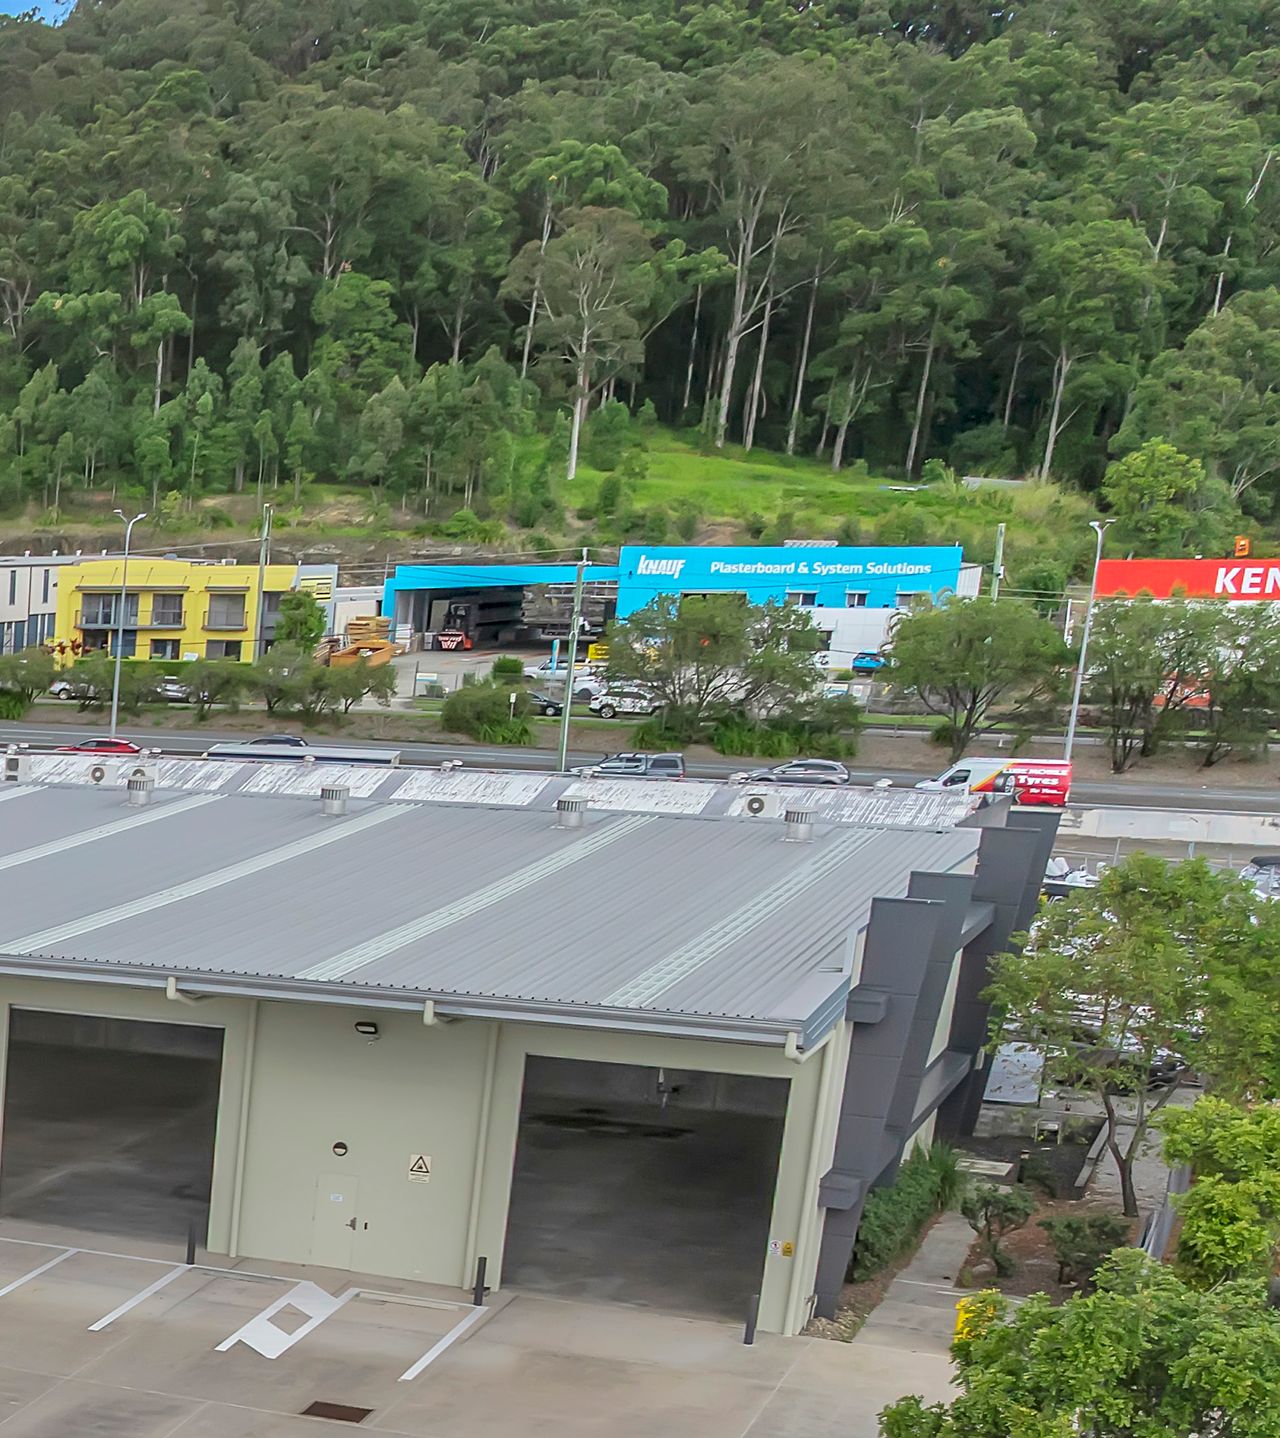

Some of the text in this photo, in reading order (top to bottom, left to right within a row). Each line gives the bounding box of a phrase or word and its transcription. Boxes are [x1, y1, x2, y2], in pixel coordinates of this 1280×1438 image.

[710, 561, 931, 576] Plasterboard & System Solutions
[1017, 775, 1059, 785] Tyres
